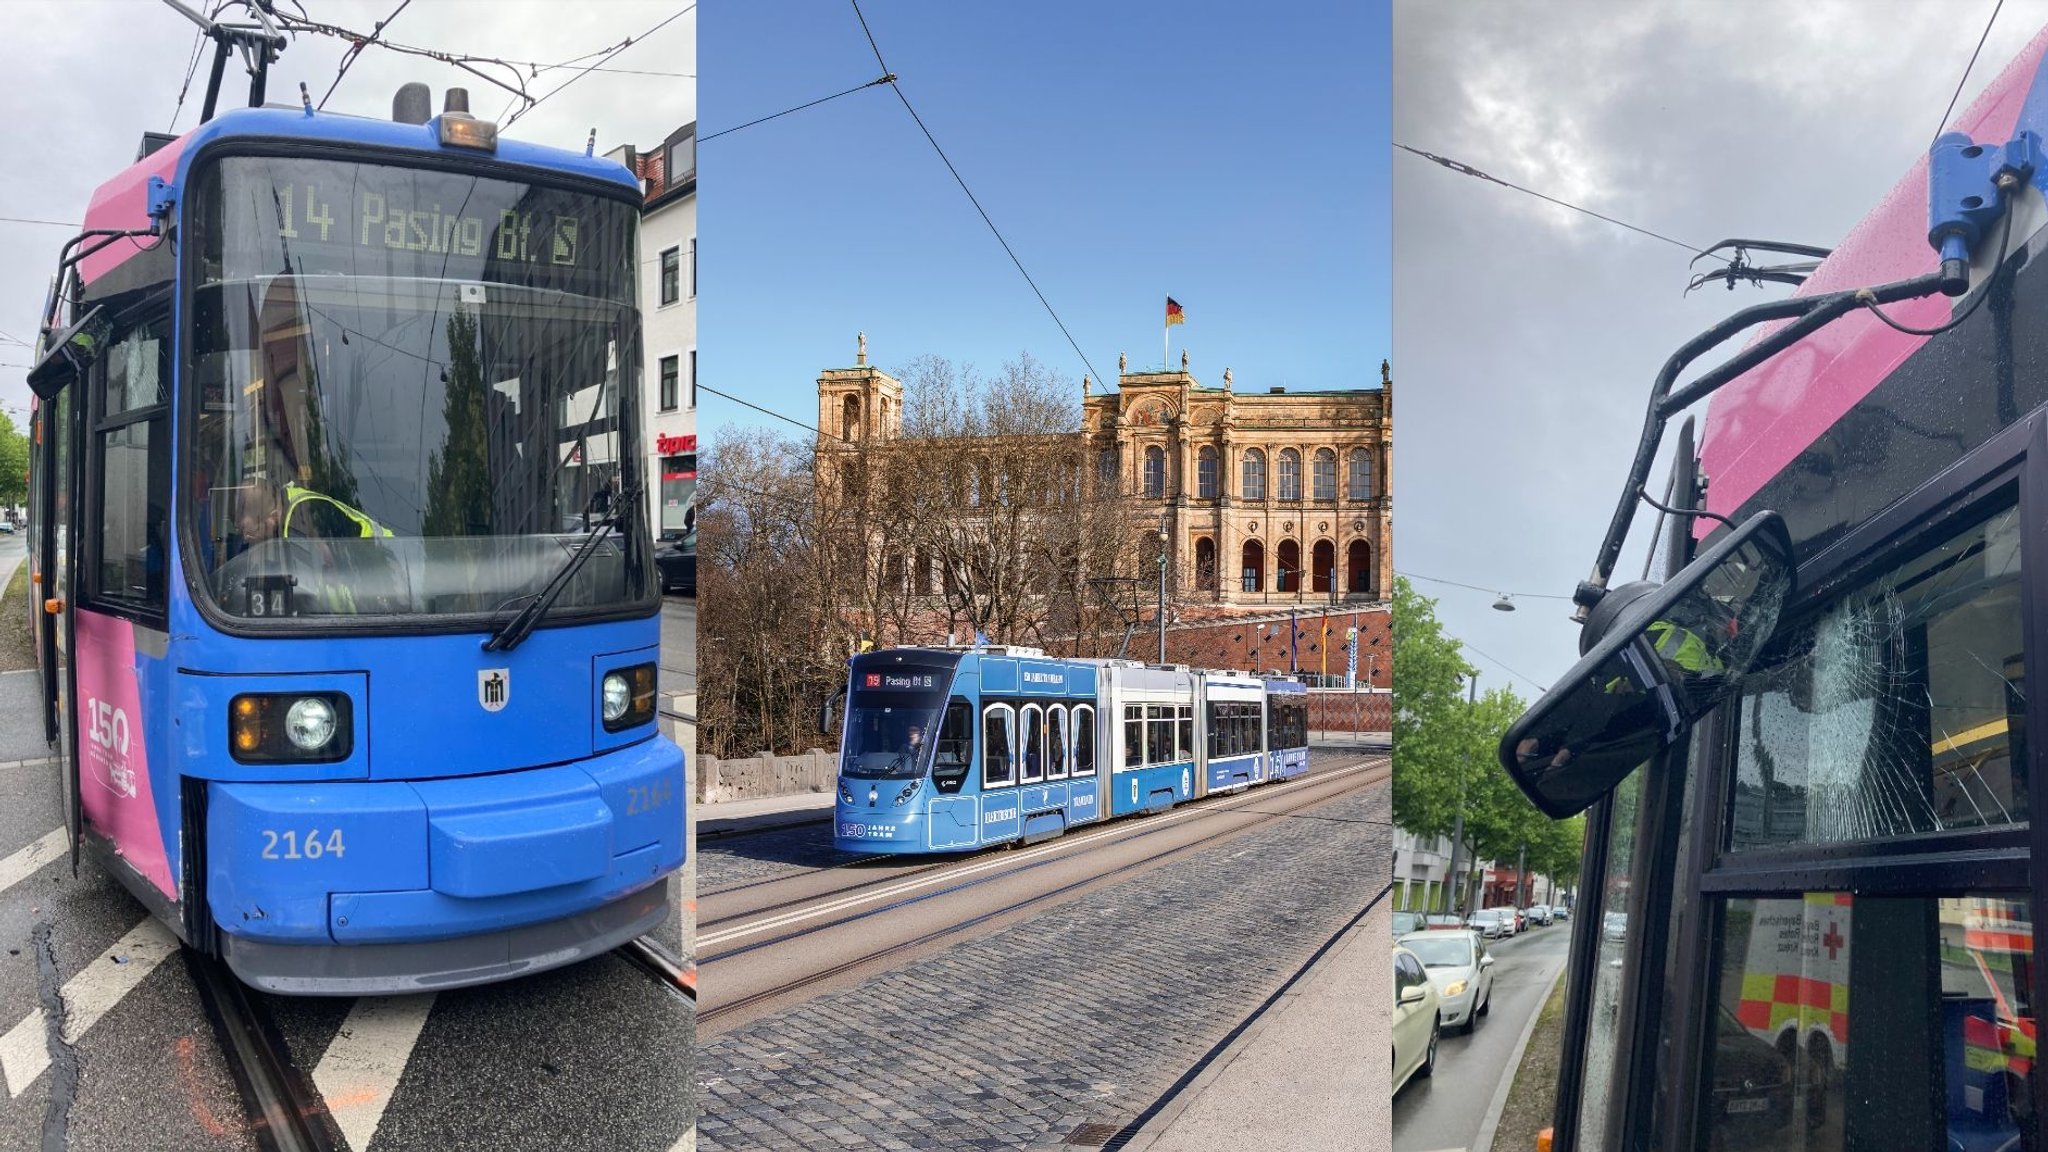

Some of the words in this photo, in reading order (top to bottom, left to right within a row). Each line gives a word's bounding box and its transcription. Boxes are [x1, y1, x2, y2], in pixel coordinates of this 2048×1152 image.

[279, 183, 334, 242] 14
[361, 191, 483, 257] Pasing
[496, 207, 537, 263] Bf.
[885, 676, 911, 688] Pasing
[88, 697, 130, 754] 150
[261, 829, 346, 860] 2164
[841, 823, 866, 838] 150
